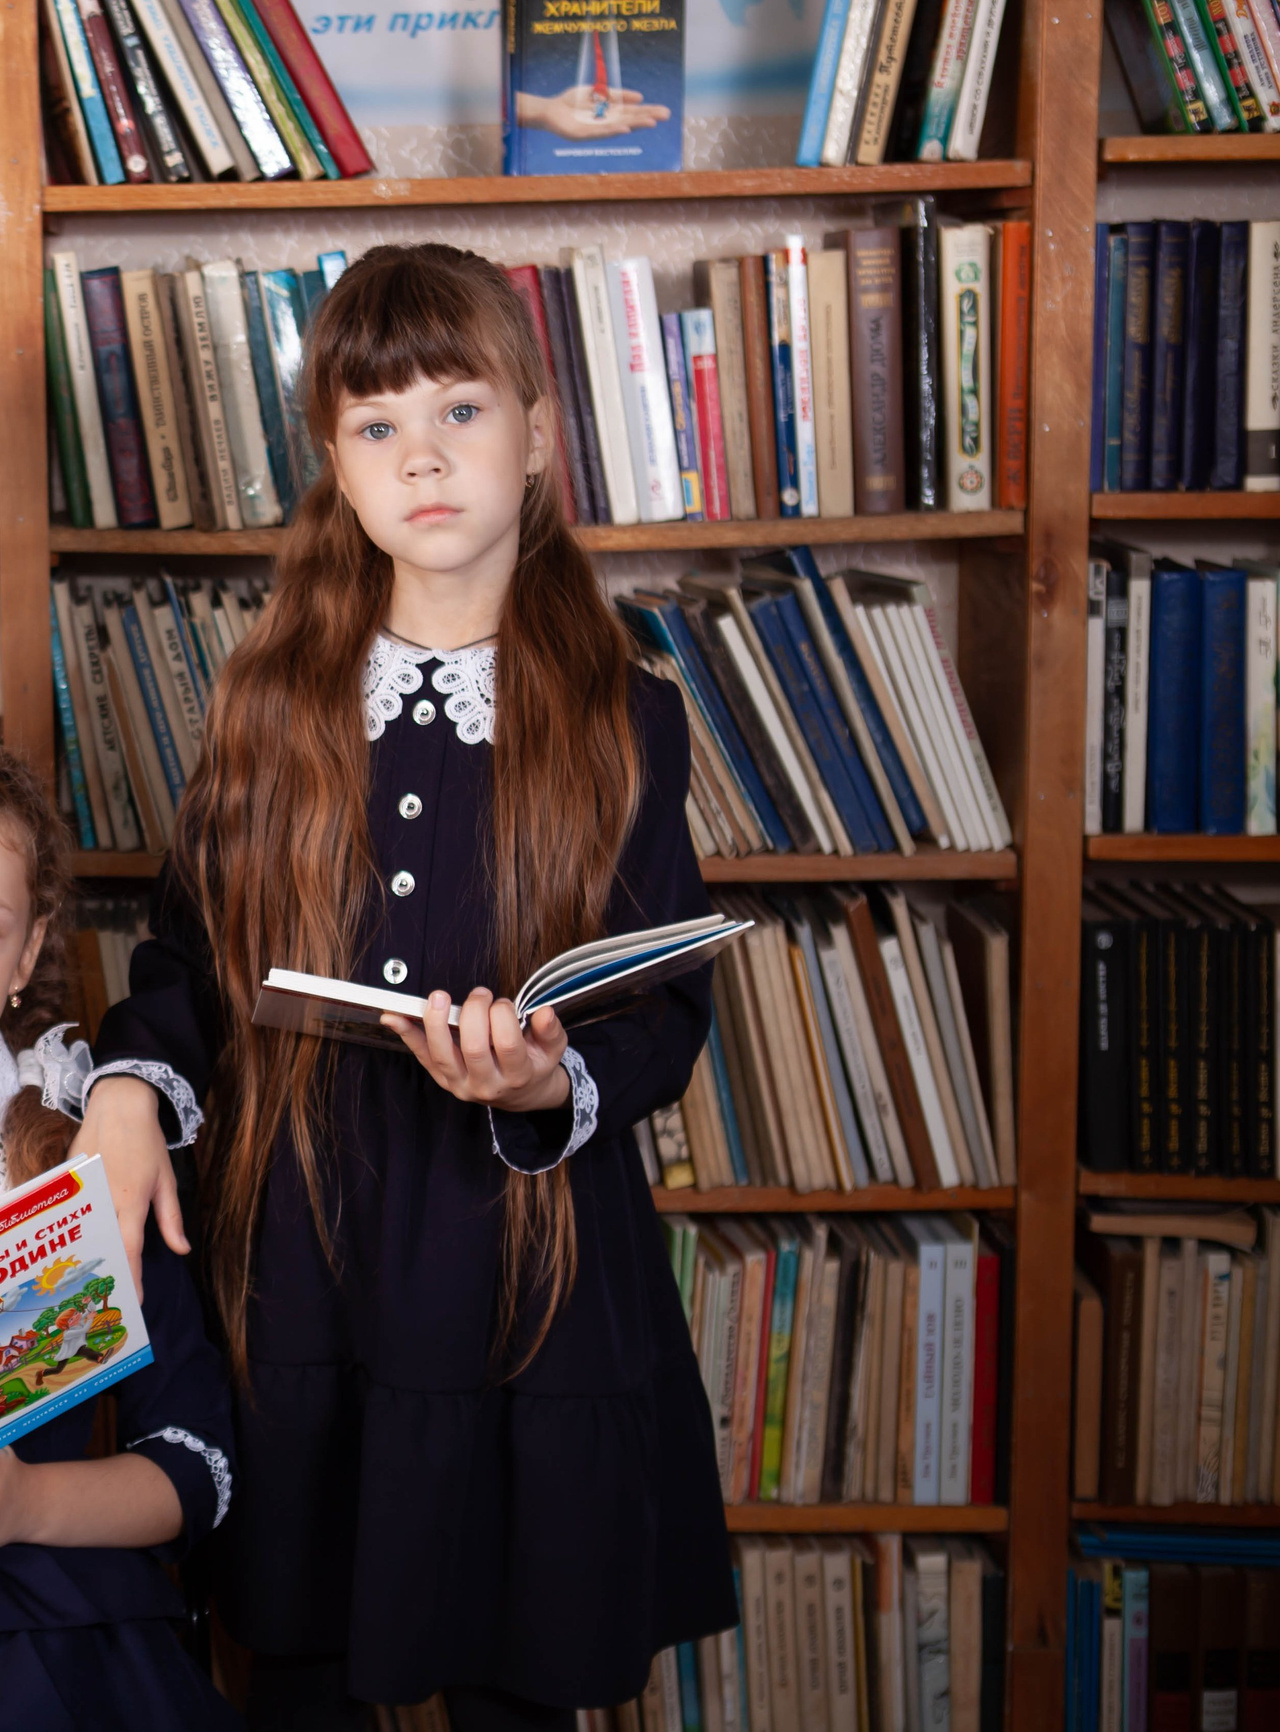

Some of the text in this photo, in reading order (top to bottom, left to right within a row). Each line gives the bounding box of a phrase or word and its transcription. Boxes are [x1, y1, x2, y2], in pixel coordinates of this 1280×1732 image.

[312, 13, 379, 35] эти
[531, 18, 679, 34] ЖЕМЧУЖНОГО ЖЕЗЛА
[544, 0, 660, 17] ХРАНИТЕЛИ
[136, 292, 153, 337] ОСТРОВ
[193, 294, 234, 506] ВАДИМ НЕЧАЕВ ВИЖУ ЗЕМЛЮ
[869, 315, 887, 467] АЛЕКСАНДР ДЮМА
[81, 624, 117, 752] ДЕТСКИЕ СЕКРЕТЫ
[164, 627, 203, 741] СТАРЫЙ ДОМ
[16, 1240, 28, 1252] И
[35, 1202, 92, 1240] СТИХИ
